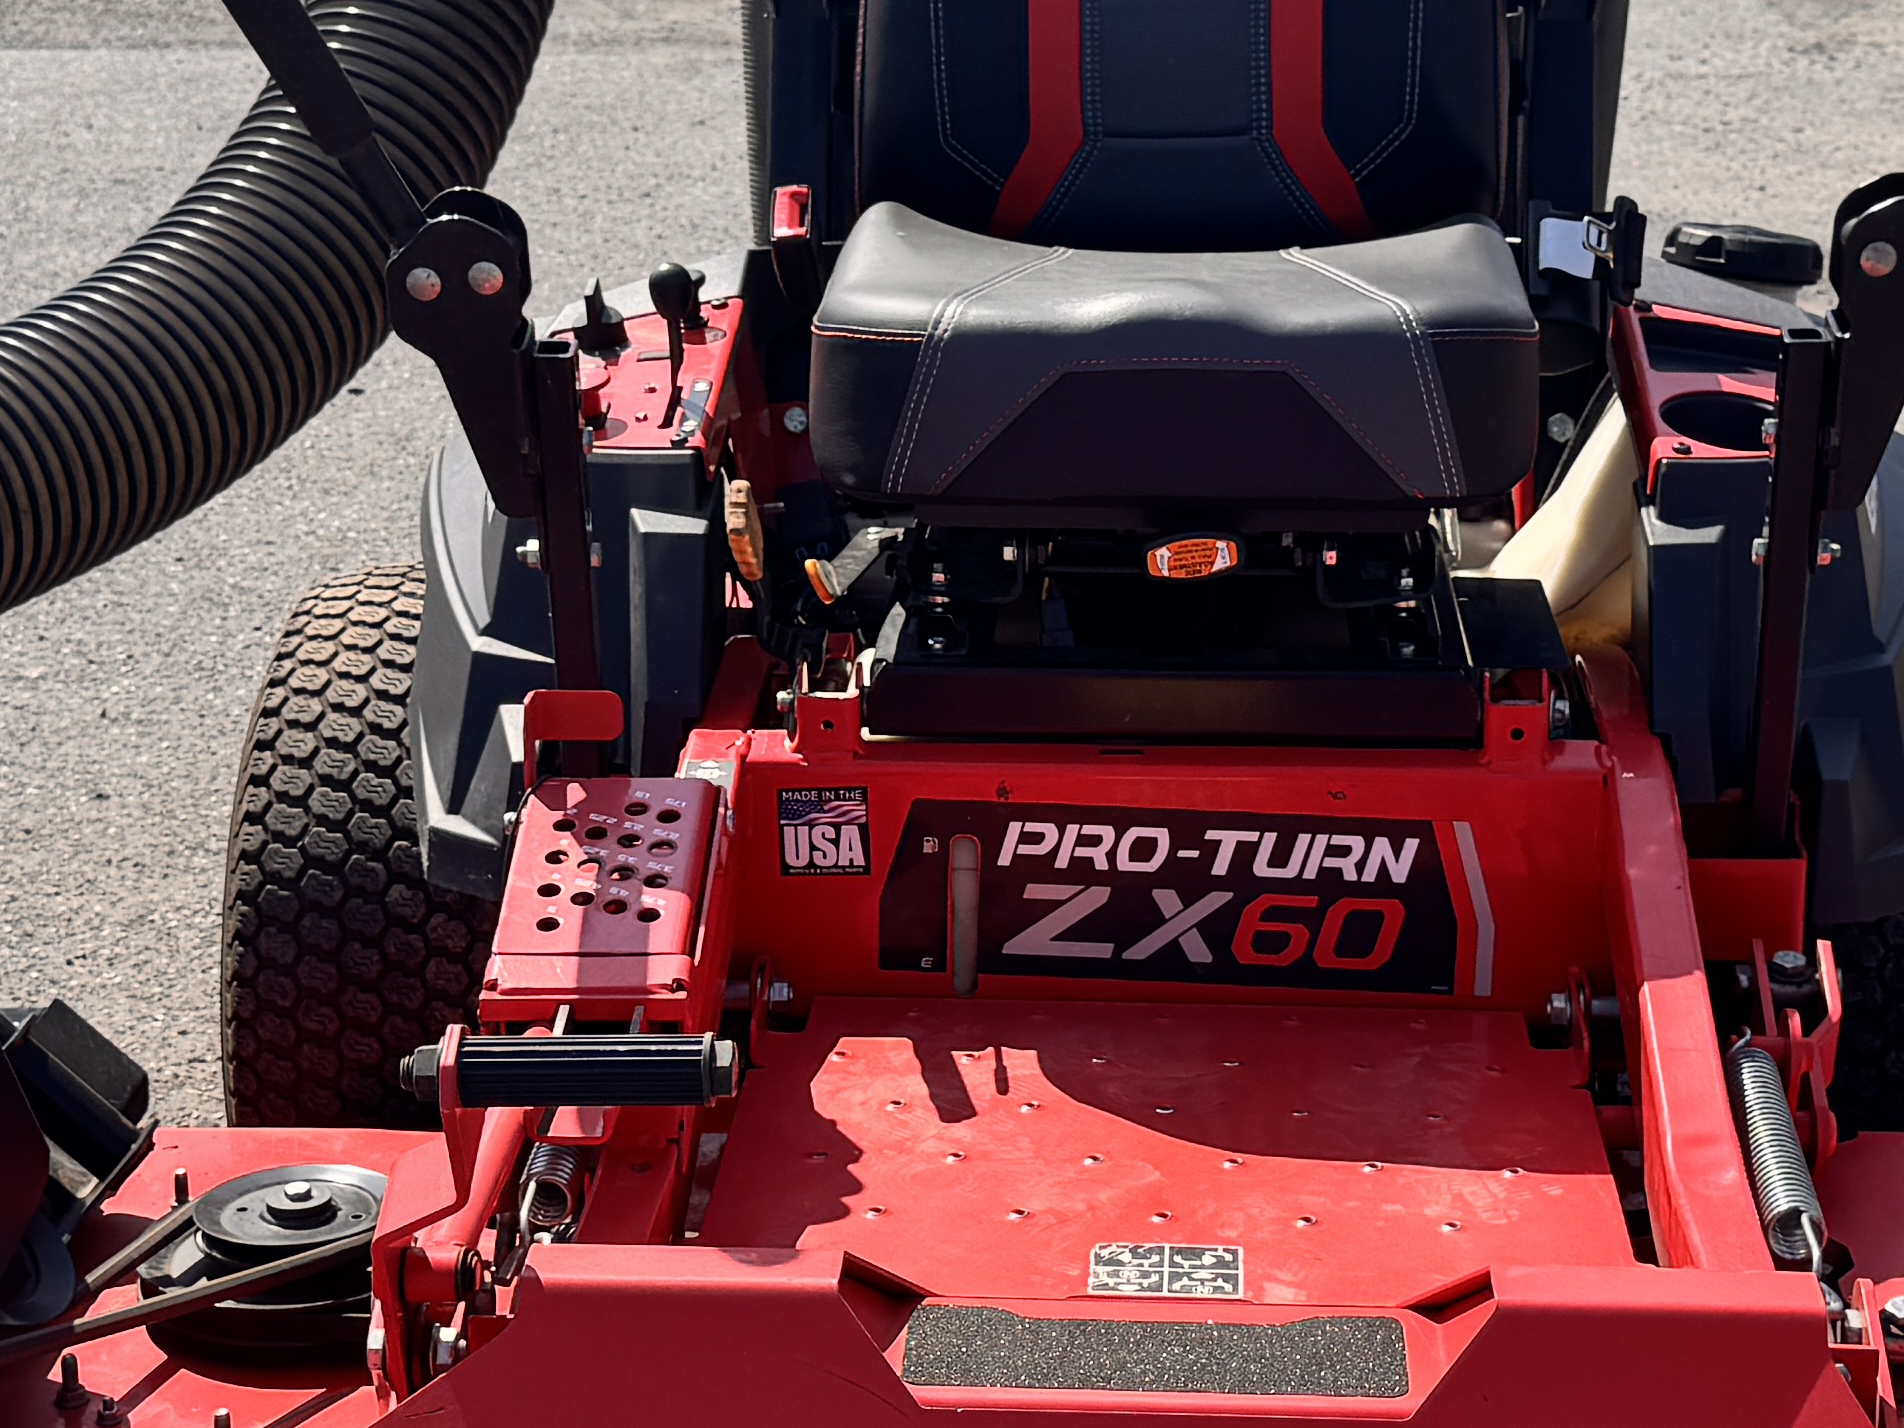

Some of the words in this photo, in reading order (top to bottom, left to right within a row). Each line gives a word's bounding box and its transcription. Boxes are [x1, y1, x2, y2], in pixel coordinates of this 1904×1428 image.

[782, 791, 819, 801] MADE
[822, 790, 835, 800] IN
[839, 789, 864, 800] THE
[783, 824, 866, 868] USA
[997, 820, 1421, 885] PRO-TURN
[1001, 883, 1407, 970] ZX60
